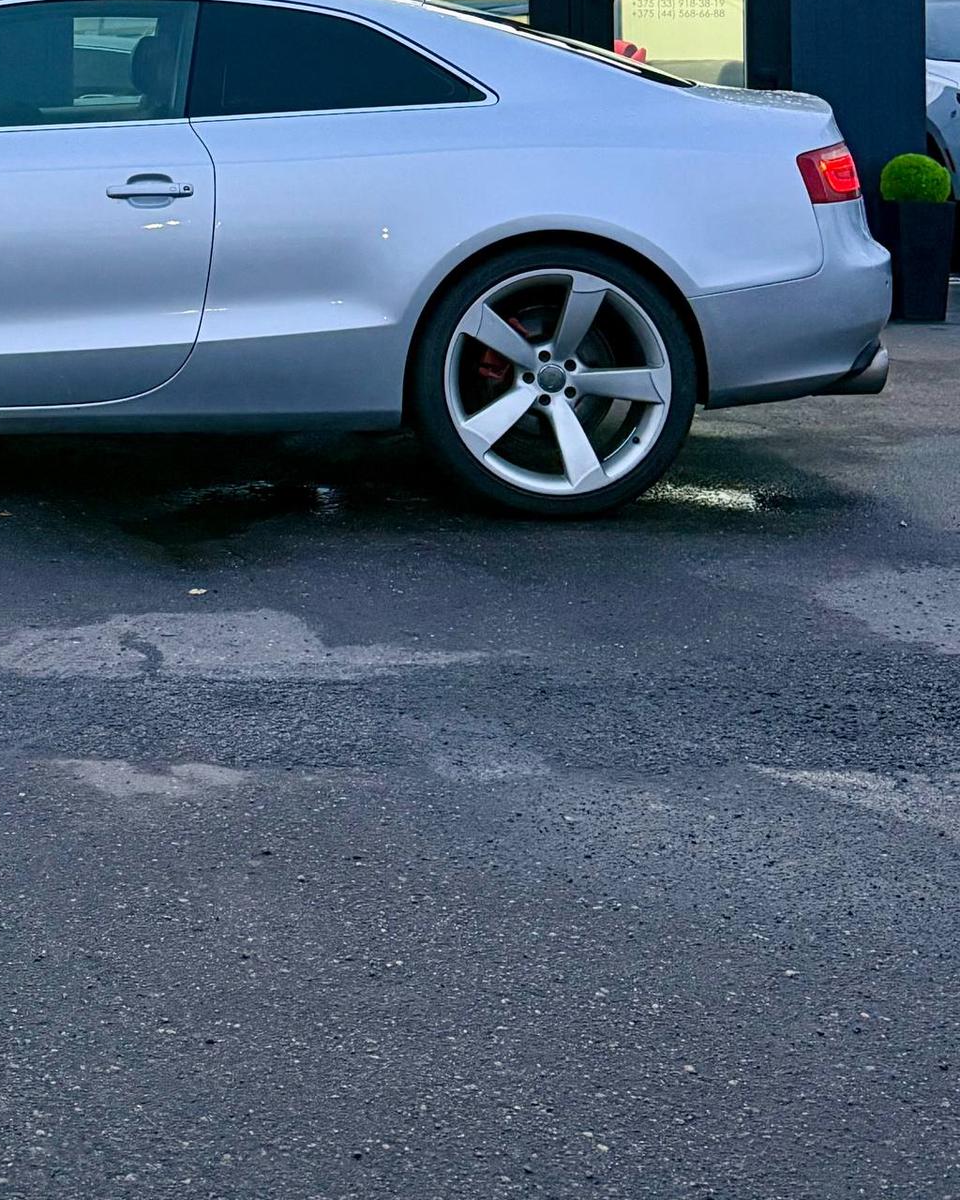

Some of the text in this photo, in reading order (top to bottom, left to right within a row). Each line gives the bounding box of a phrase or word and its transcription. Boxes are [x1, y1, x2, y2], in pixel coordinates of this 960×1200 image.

[632, 0, 726, 9] +375 (33) 918-38-19
[632, 9, 726, 19] +375 (44) 568-66-88
